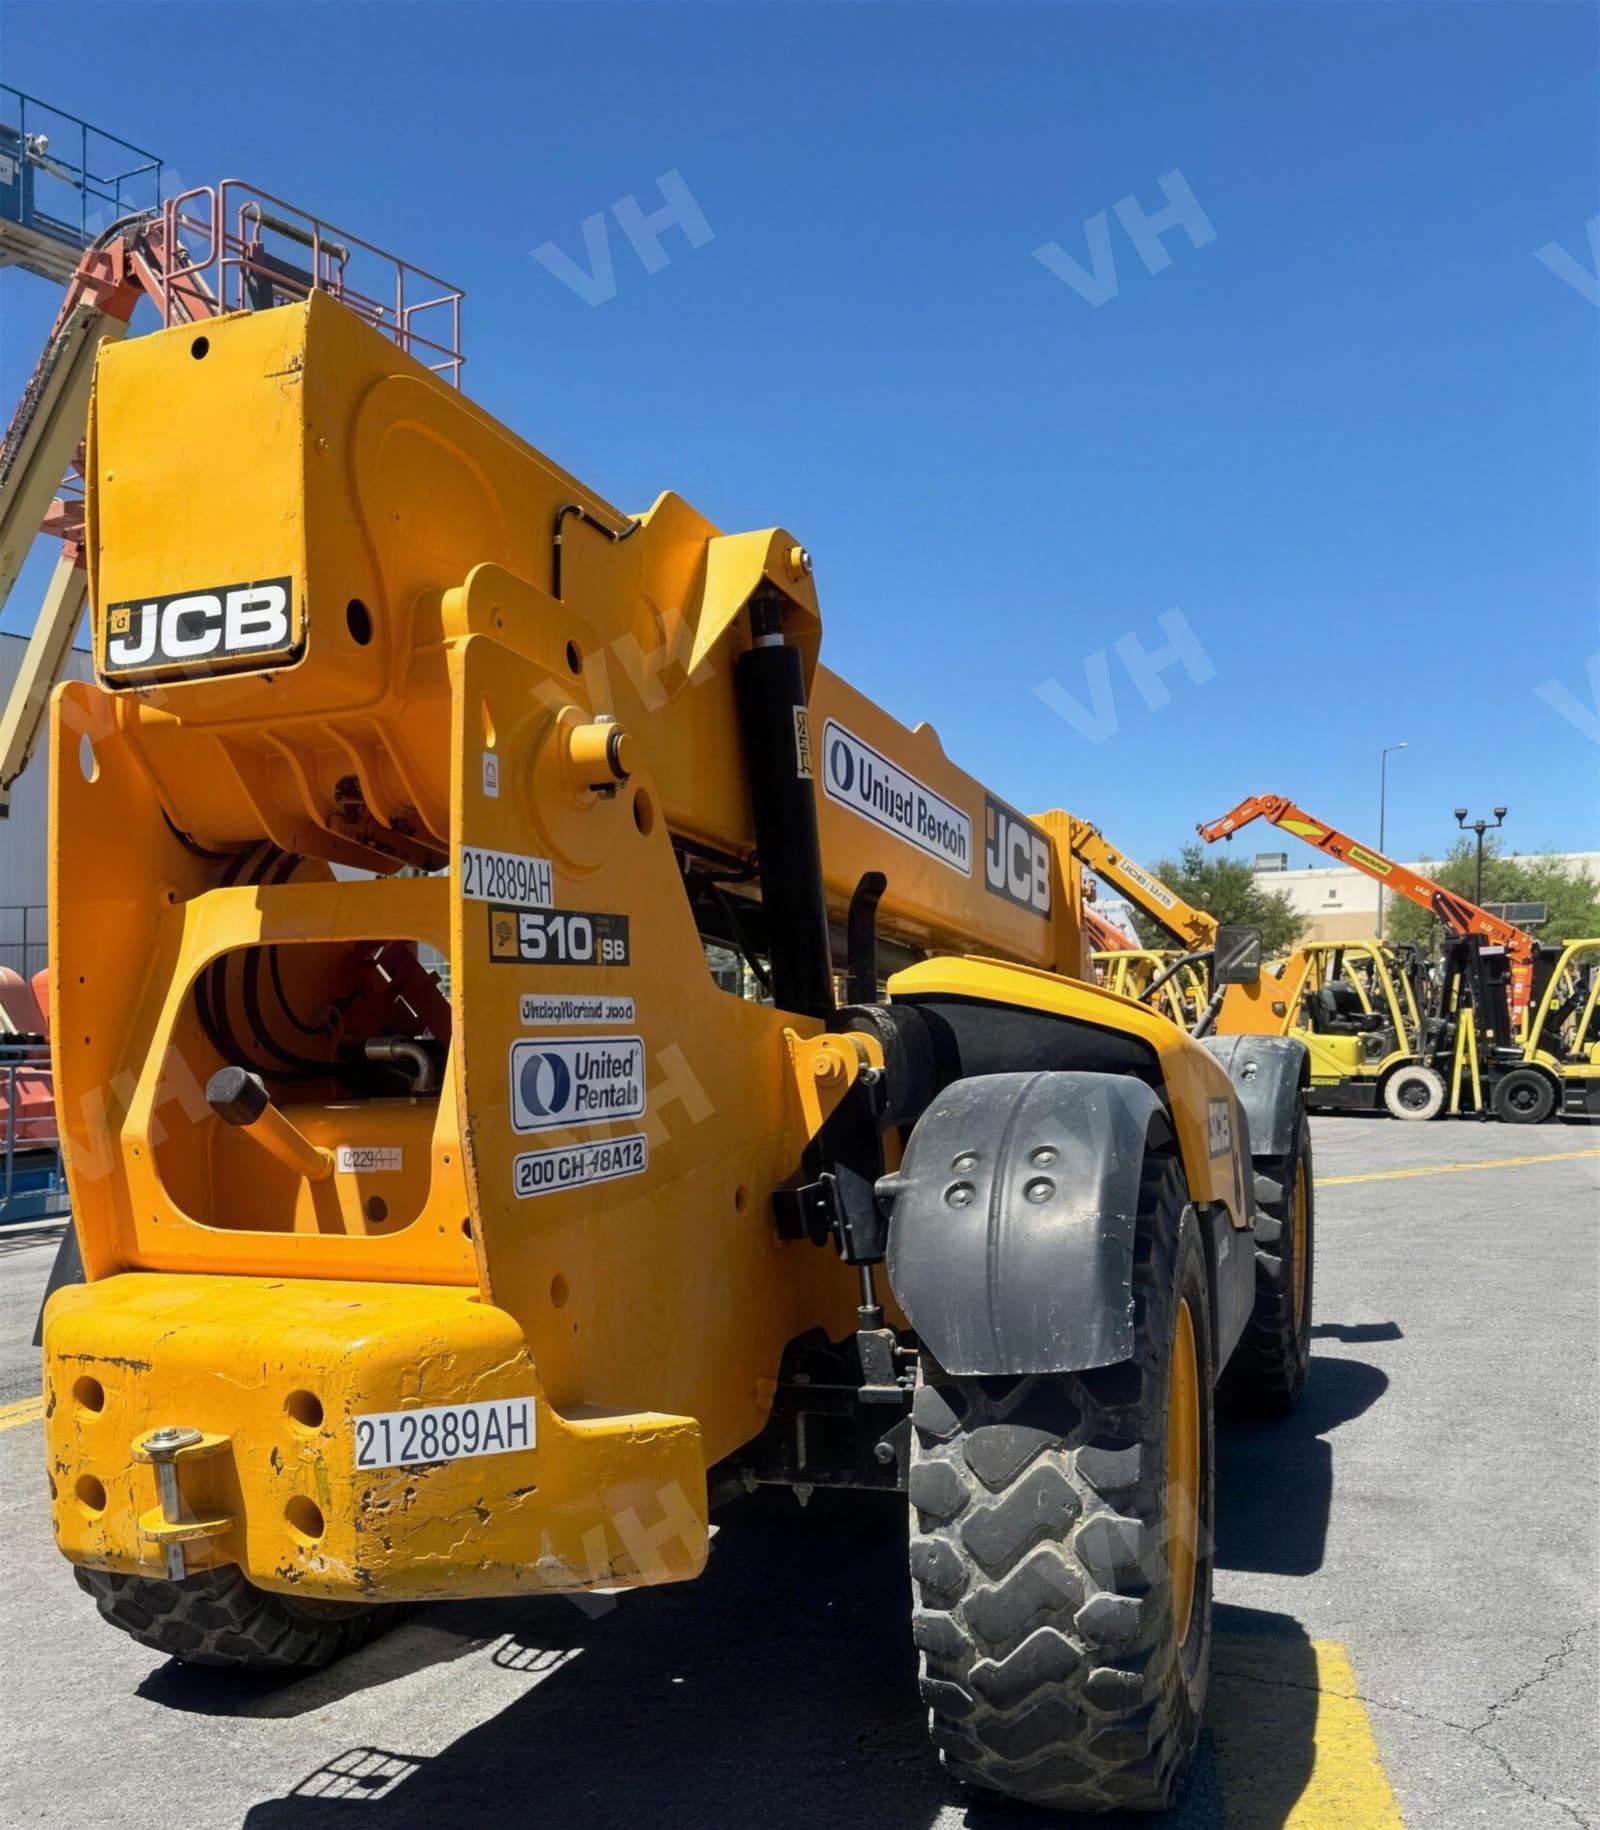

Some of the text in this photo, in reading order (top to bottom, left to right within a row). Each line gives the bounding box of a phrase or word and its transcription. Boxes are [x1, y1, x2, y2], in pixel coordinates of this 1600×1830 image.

[110, 586, 288, 664] JCB
[463, 851, 553, 905] 212889AH
[987, 807, 1050, 912] JCB
[519, 913, 593, 960] 510
[575, 1050, 634, 1081] United
[521, 1160, 554, 1187] 200
[356, 1403, 528, 1466] 212889AH
